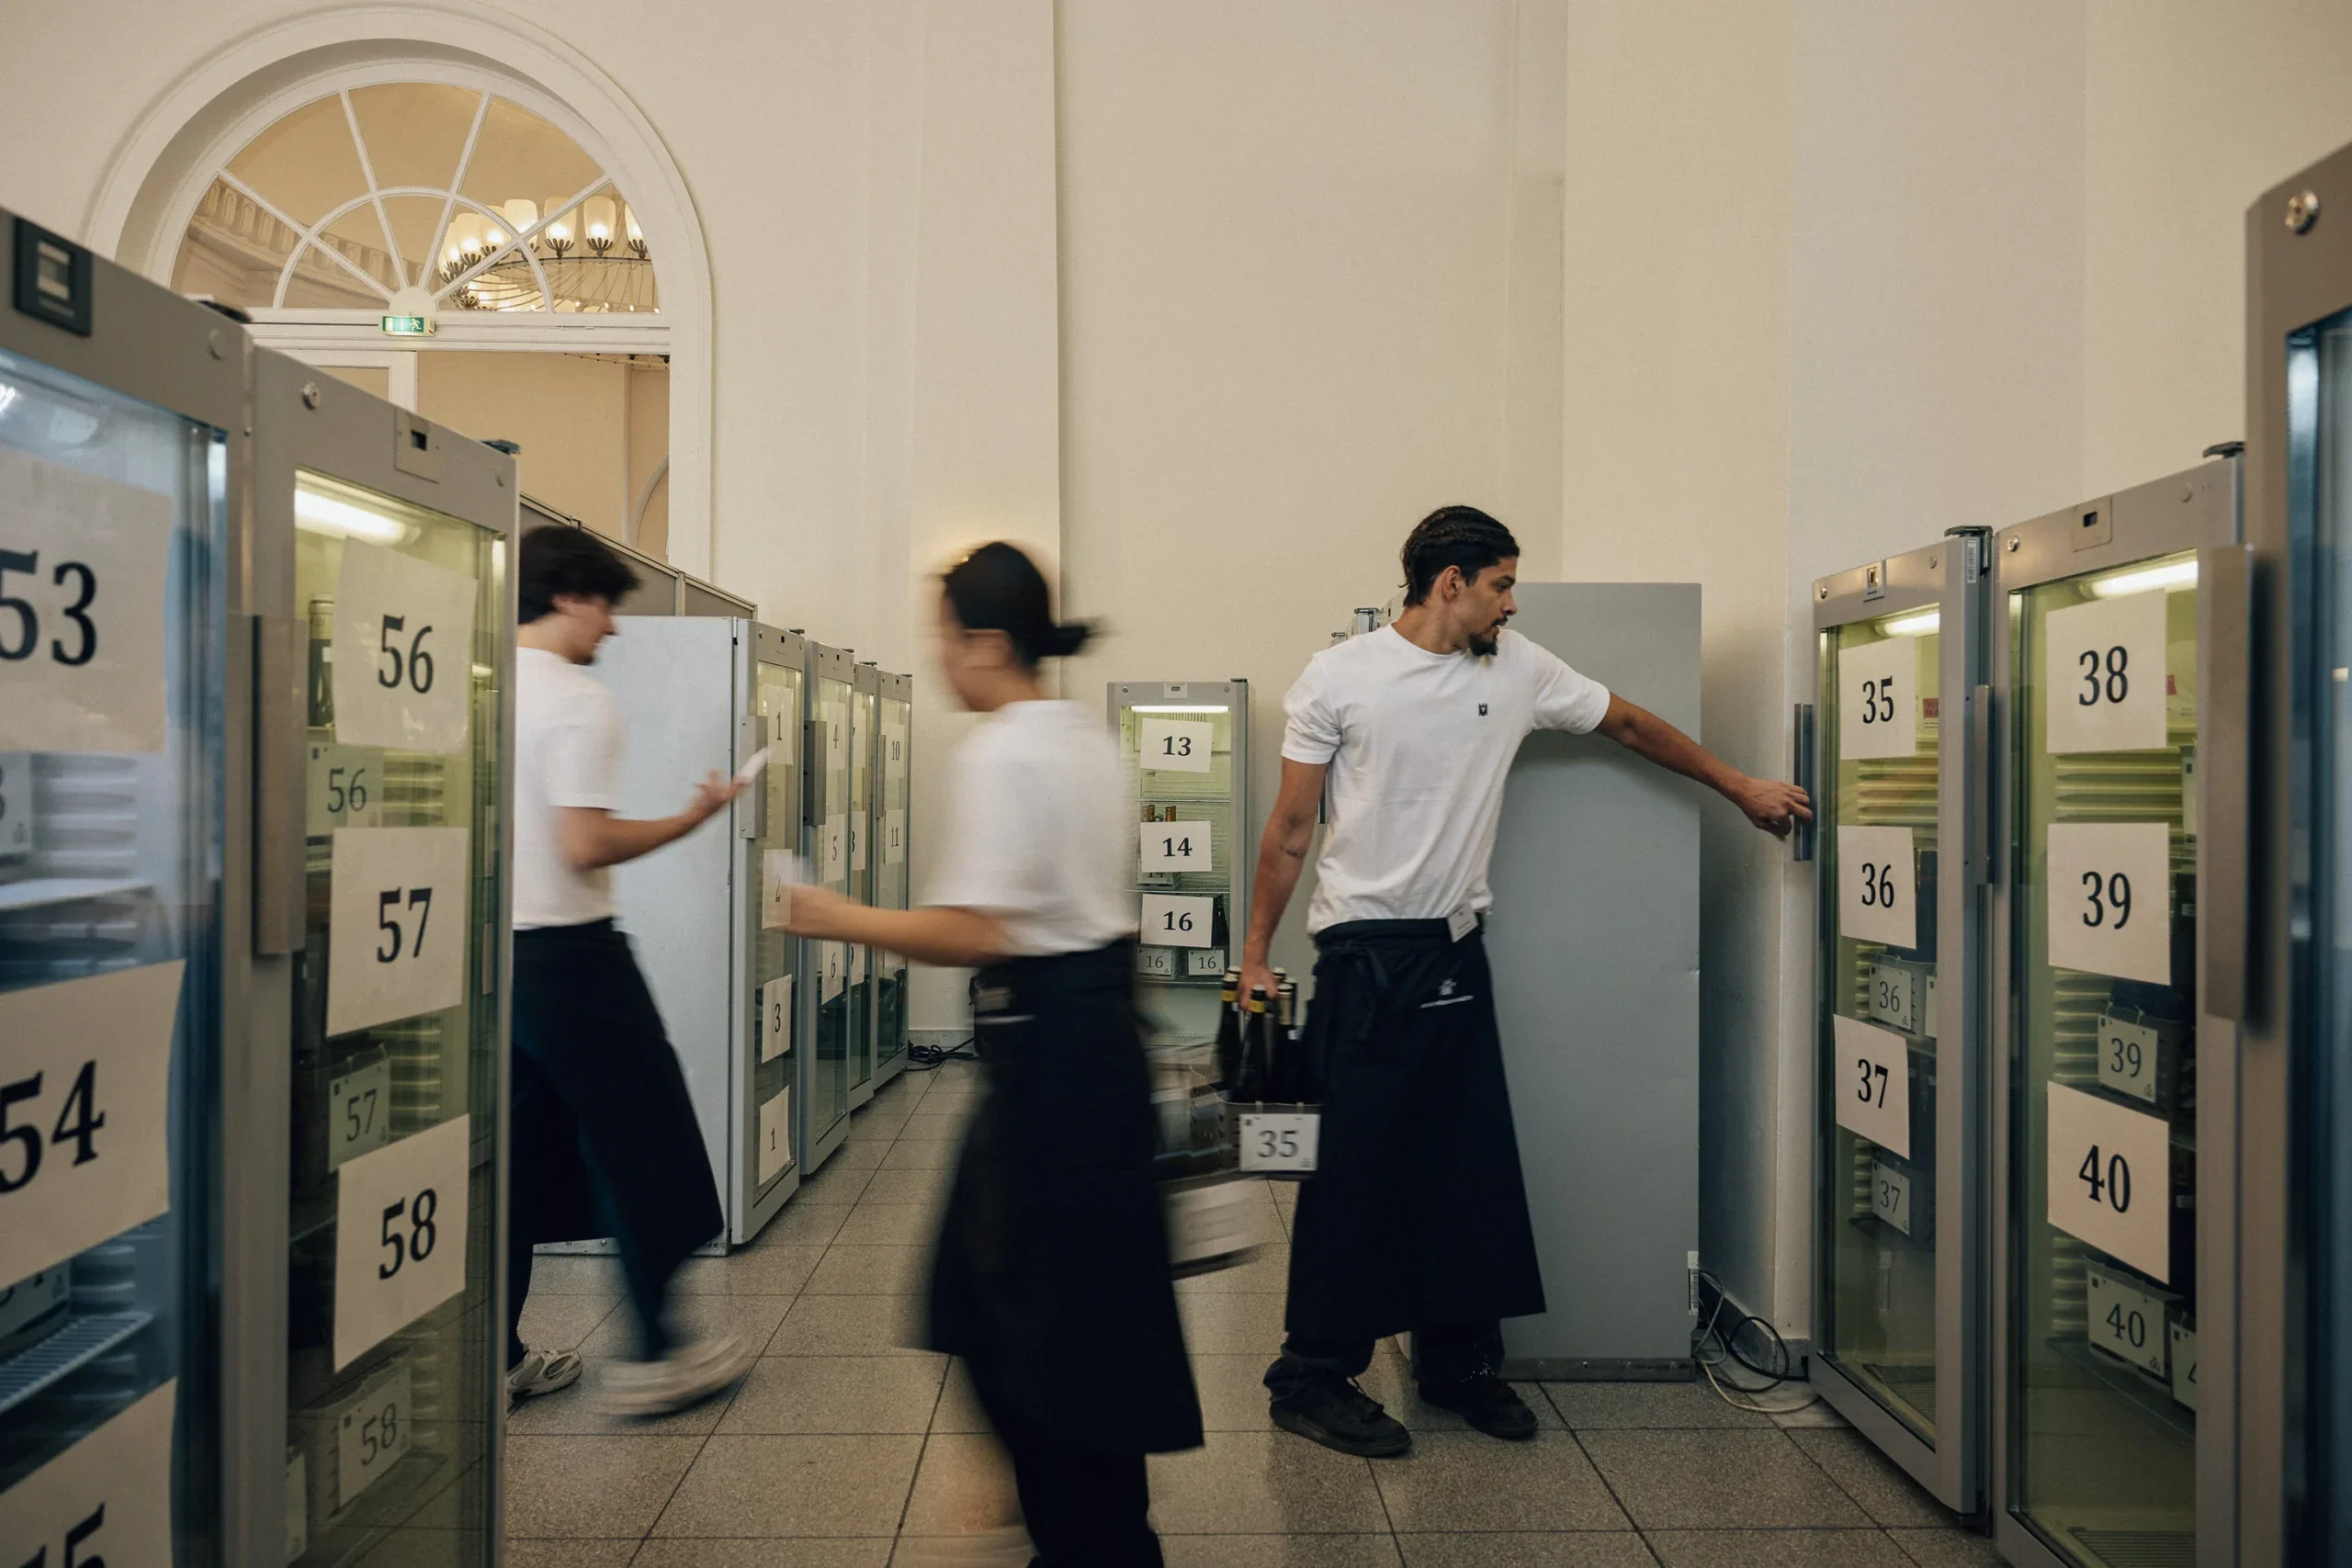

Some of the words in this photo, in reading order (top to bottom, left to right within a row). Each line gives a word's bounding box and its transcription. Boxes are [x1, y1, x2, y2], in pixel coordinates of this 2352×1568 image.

[0, 548, 97, 666] 53
[378, 614, 433, 694] 56
[2078, 645, 2129, 706] 38
[1862, 675, 1894, 725] 35
[776, 711, 782, 741] 1
[832, 723, 838, 750] 4
[891, 739, 900, 761] 10
[1162, 736, 1192, 756] 13
[327, 767, 367, 812] 56
[831, 835, 837, 862] 5
[890, 826, 899, 848] 11
[1162, 837, 1193, 857] 14
[1861, 863, 1894, 908] 36
[2082, 871, 2132, 931] 39
[377, 887, 433, 964] 57
[1163, 910, 1193, 931] 16
[831, 953, 836, 978] 6
[1147, 954, 1164, 968] 16
[1198, 955, 1216, 970] 16
[1879, 980, 1900, 1012] 36
[775, 1002, 781, 1033] 3
[2110, 1037, 2142, 1078] 39
[1857, 1058, 1889, 1110] 37
[0, 1060, 106, 1194] 54
[346, 1088, 378, 1143] 57
[770, 1127, 776, 1152] 1
[1258, 1130, 1299, 1157] 35
[1880, 1179, 1901, 1213] 37
[2078, 1145, 2132, 1213] 40
[379, 1188, 437, 1280] 58
[2106, 1303, 2146, 1348] 40
[360, 1403, 397, 1467] 58
